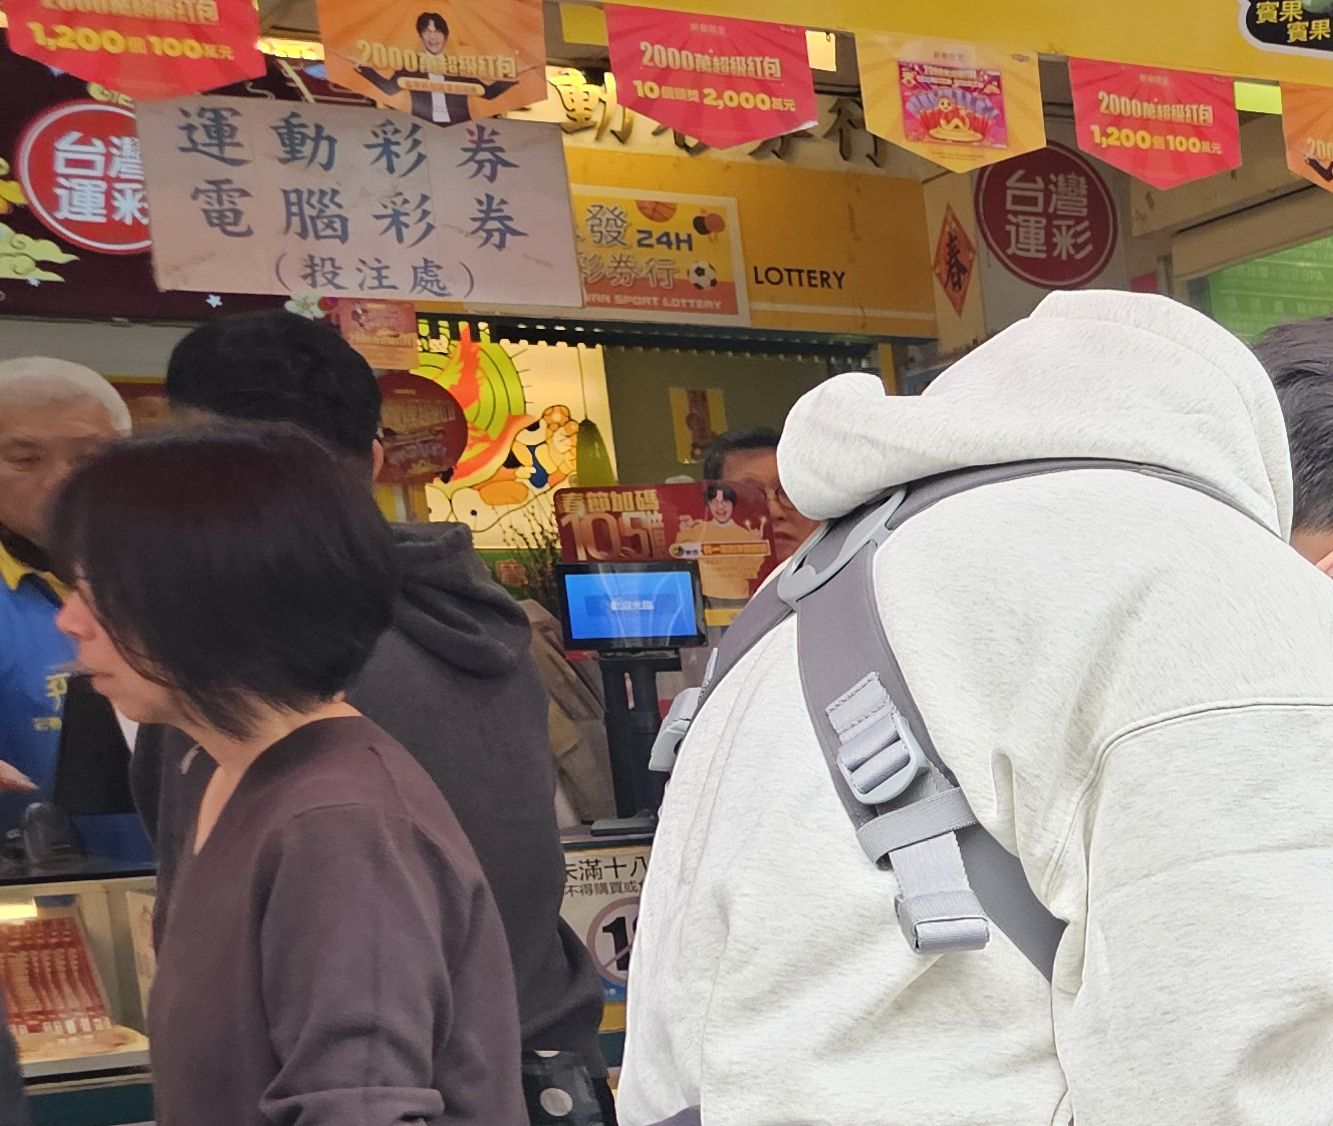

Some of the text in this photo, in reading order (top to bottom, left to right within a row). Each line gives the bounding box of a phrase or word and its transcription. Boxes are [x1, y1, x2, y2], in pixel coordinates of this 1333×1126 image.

[1256, 1, 1303, 24] 賓果
[1287, 19, 1331, 43] 賓果
[639, 41, 782, 79] 2000萬超級紅包
[1097, 91, 1214, 127] 2000萬超級紅包
[177, 104, 523, 184] 運動彩券
[1005, 169, 1089, 216] 台灣
[189, 178, 531, 254] 電腦彩券
[636, 229, 694, 252] 24H
[1005, 214, 1095, 262] 運彩
[274, 250, 476, 299] (投注處)
[753, 266, 846, 291] LOTTERY
[943, 231, 968, 292] 春
[616, 293, 659, 306] SPORT
[663, 296, 722, 311] LOTTERY
[565, 881, 645, 897] 不得購買或
